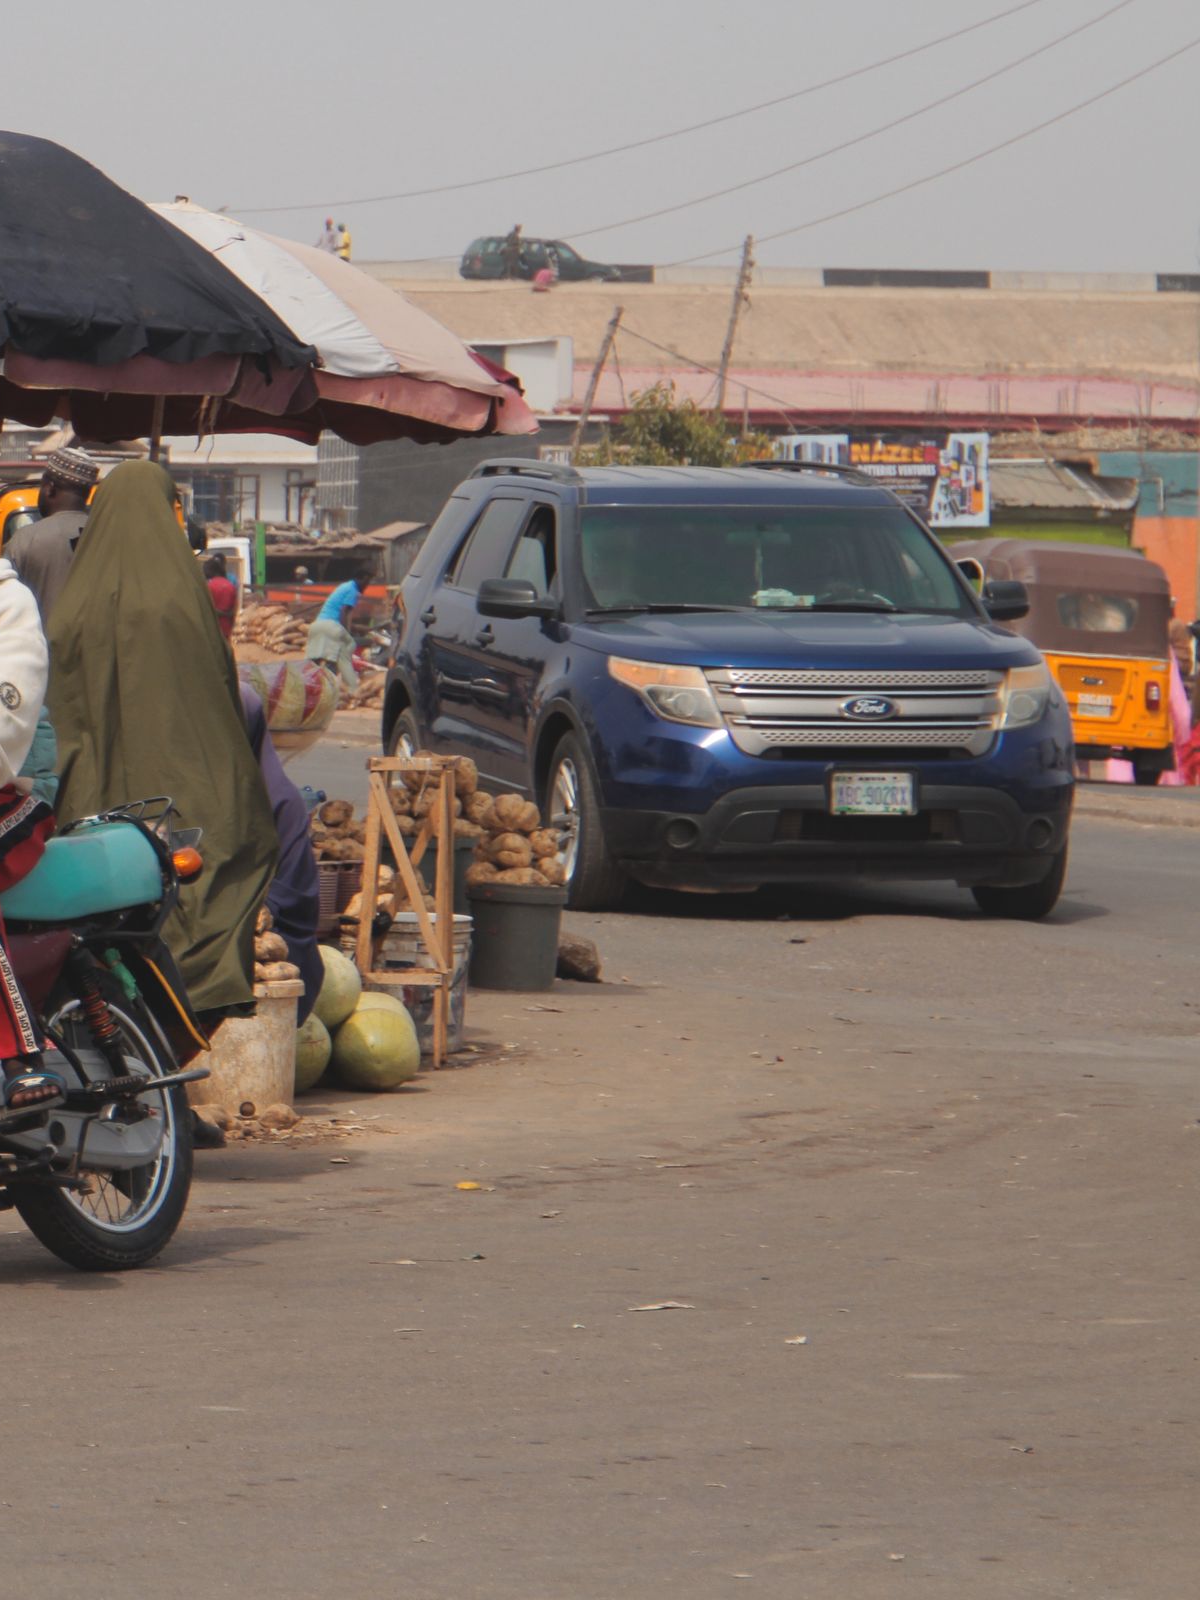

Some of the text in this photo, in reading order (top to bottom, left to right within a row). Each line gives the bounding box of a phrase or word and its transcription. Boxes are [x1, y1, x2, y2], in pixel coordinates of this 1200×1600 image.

[853, 699, 887, 713] Ford
[0, 958, 13, 978] LOVE
[5, 977, 18, 996] LOVE
[12, 995, 25, 1014] LOVE
[17, 1013, 33, 1033] LOVE
[24, 1033, 36, 1051] LOVE
